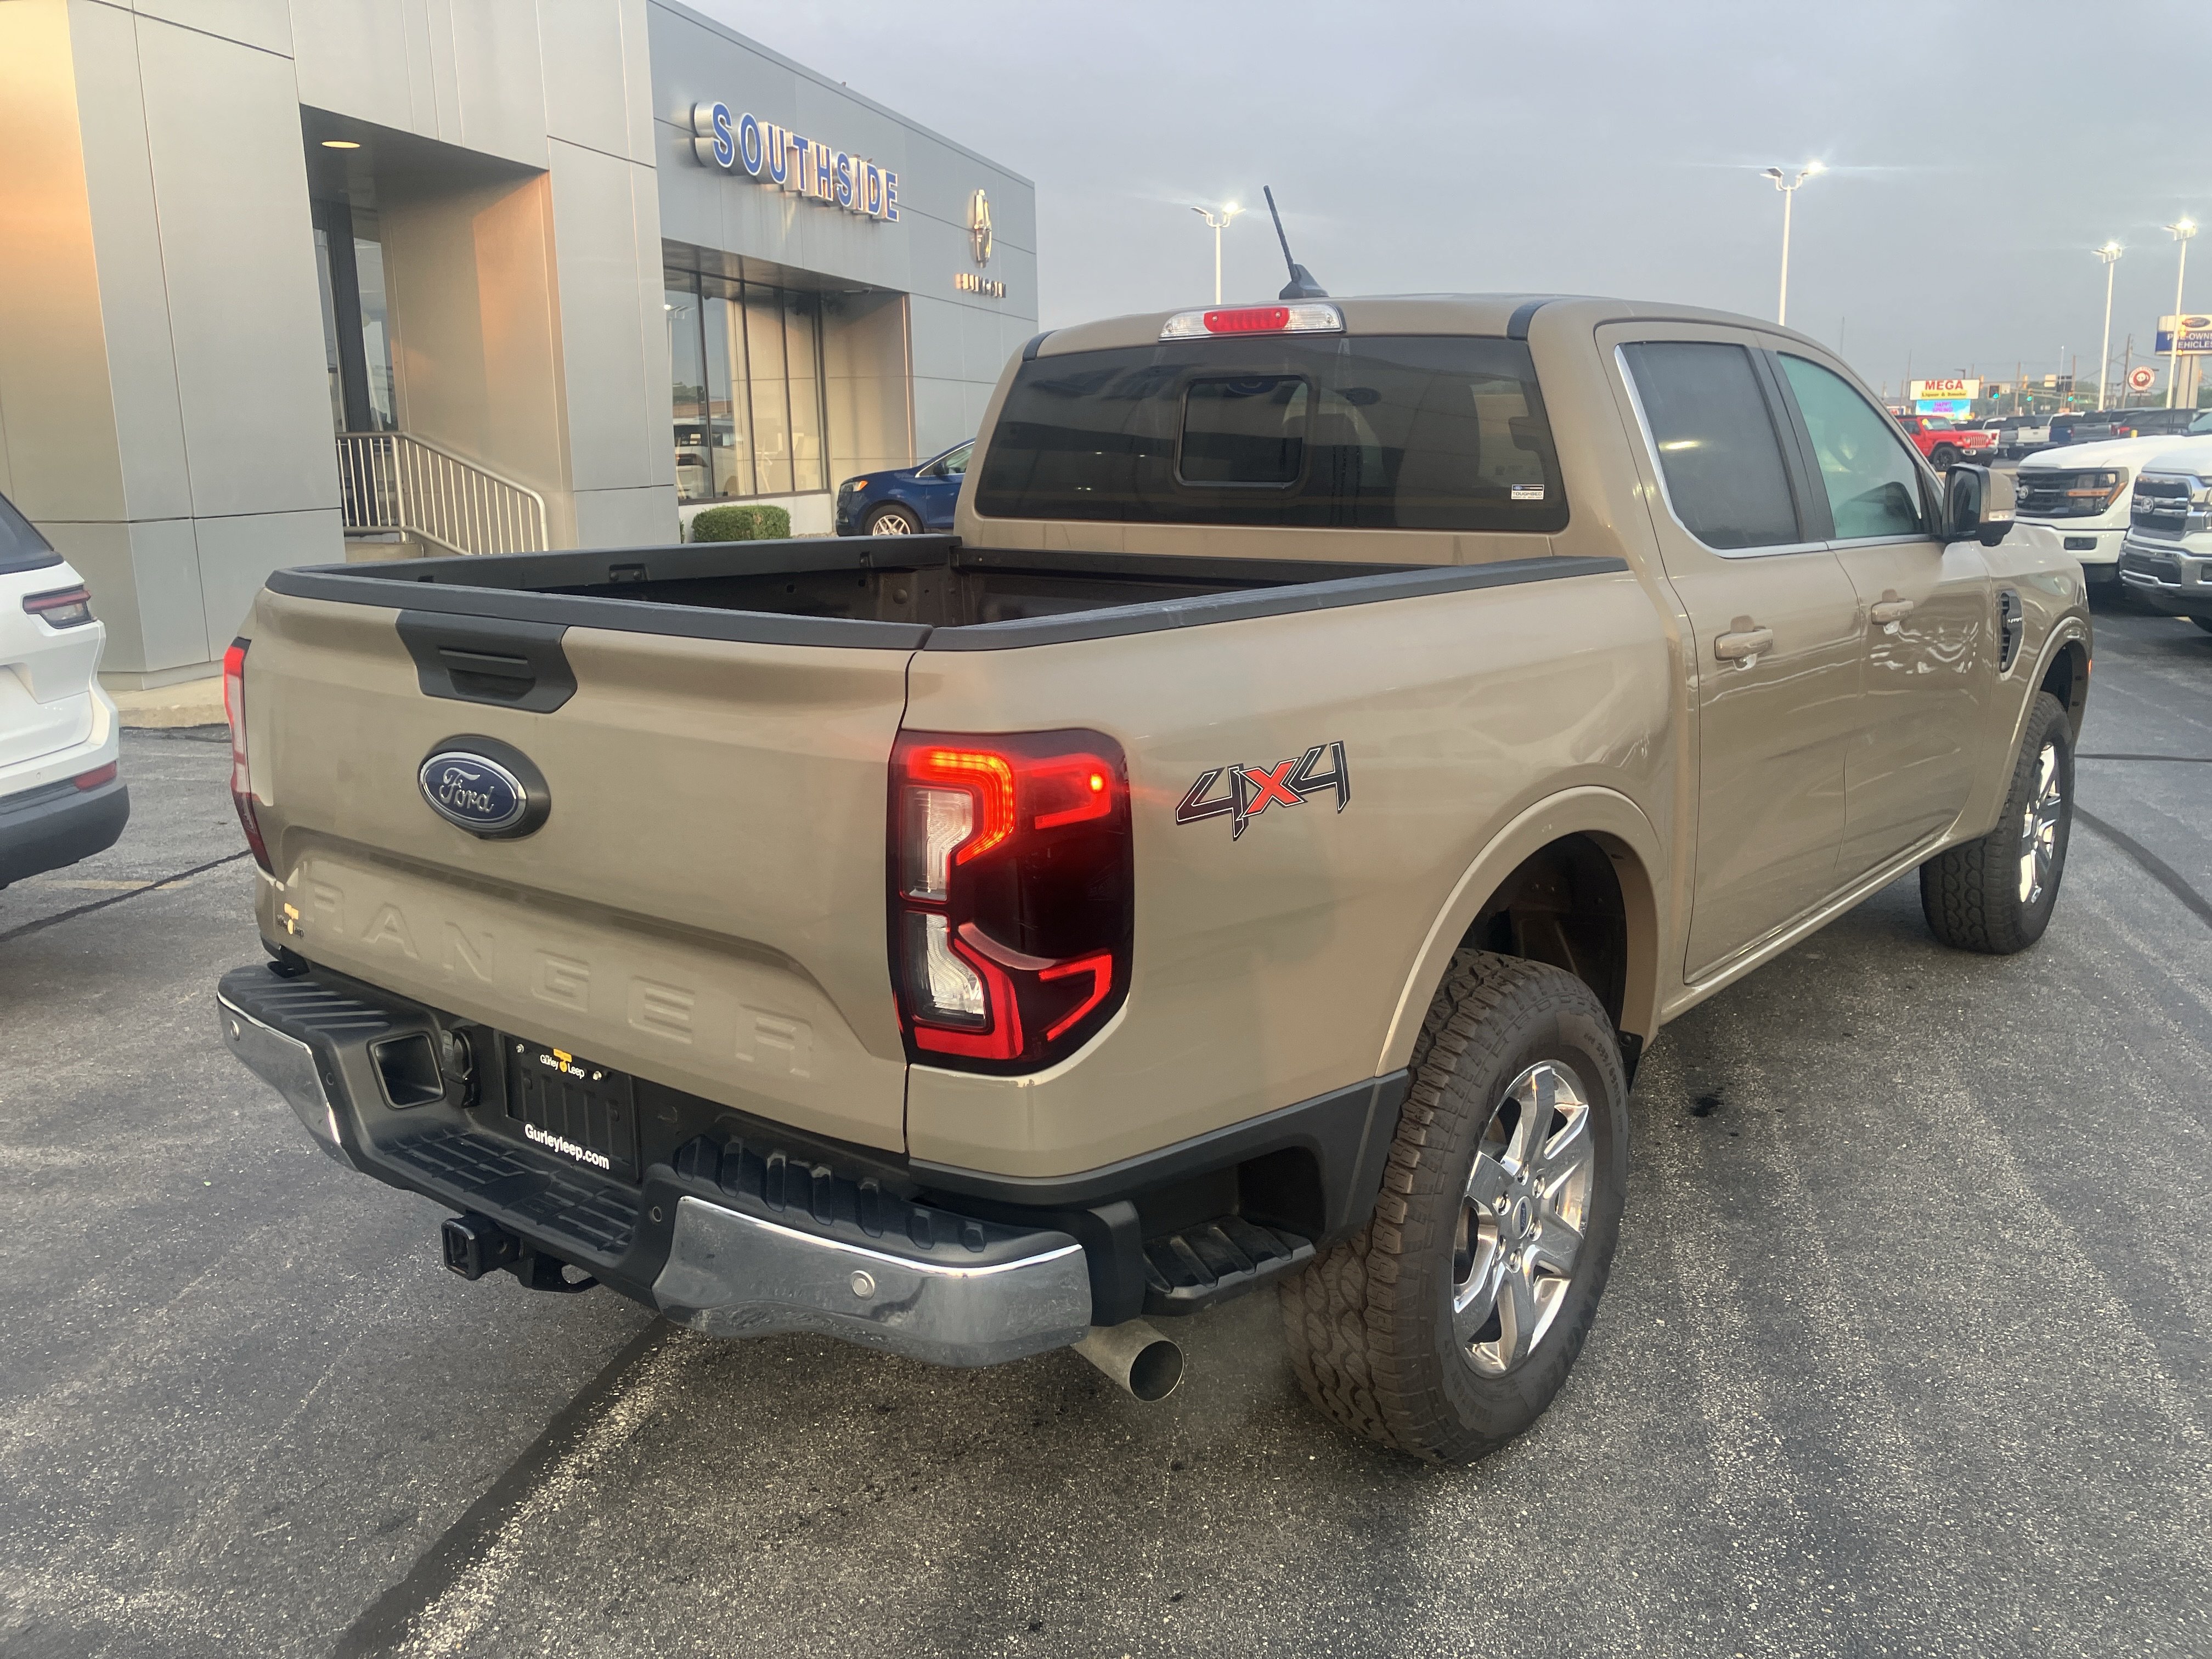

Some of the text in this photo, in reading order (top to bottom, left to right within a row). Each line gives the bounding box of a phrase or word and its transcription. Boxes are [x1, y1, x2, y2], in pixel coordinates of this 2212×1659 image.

[711, 101, 900, 223] SOUTHSIDE
[1925, 379, 1964, 390] MEGA
[439, 767, 495, 813] Ford
[303, 878, 813, 1078] RANGER
[567, 1063, 585, 1080] Leep
[524, 1124, 610, 1170] Gurleyleep.com
